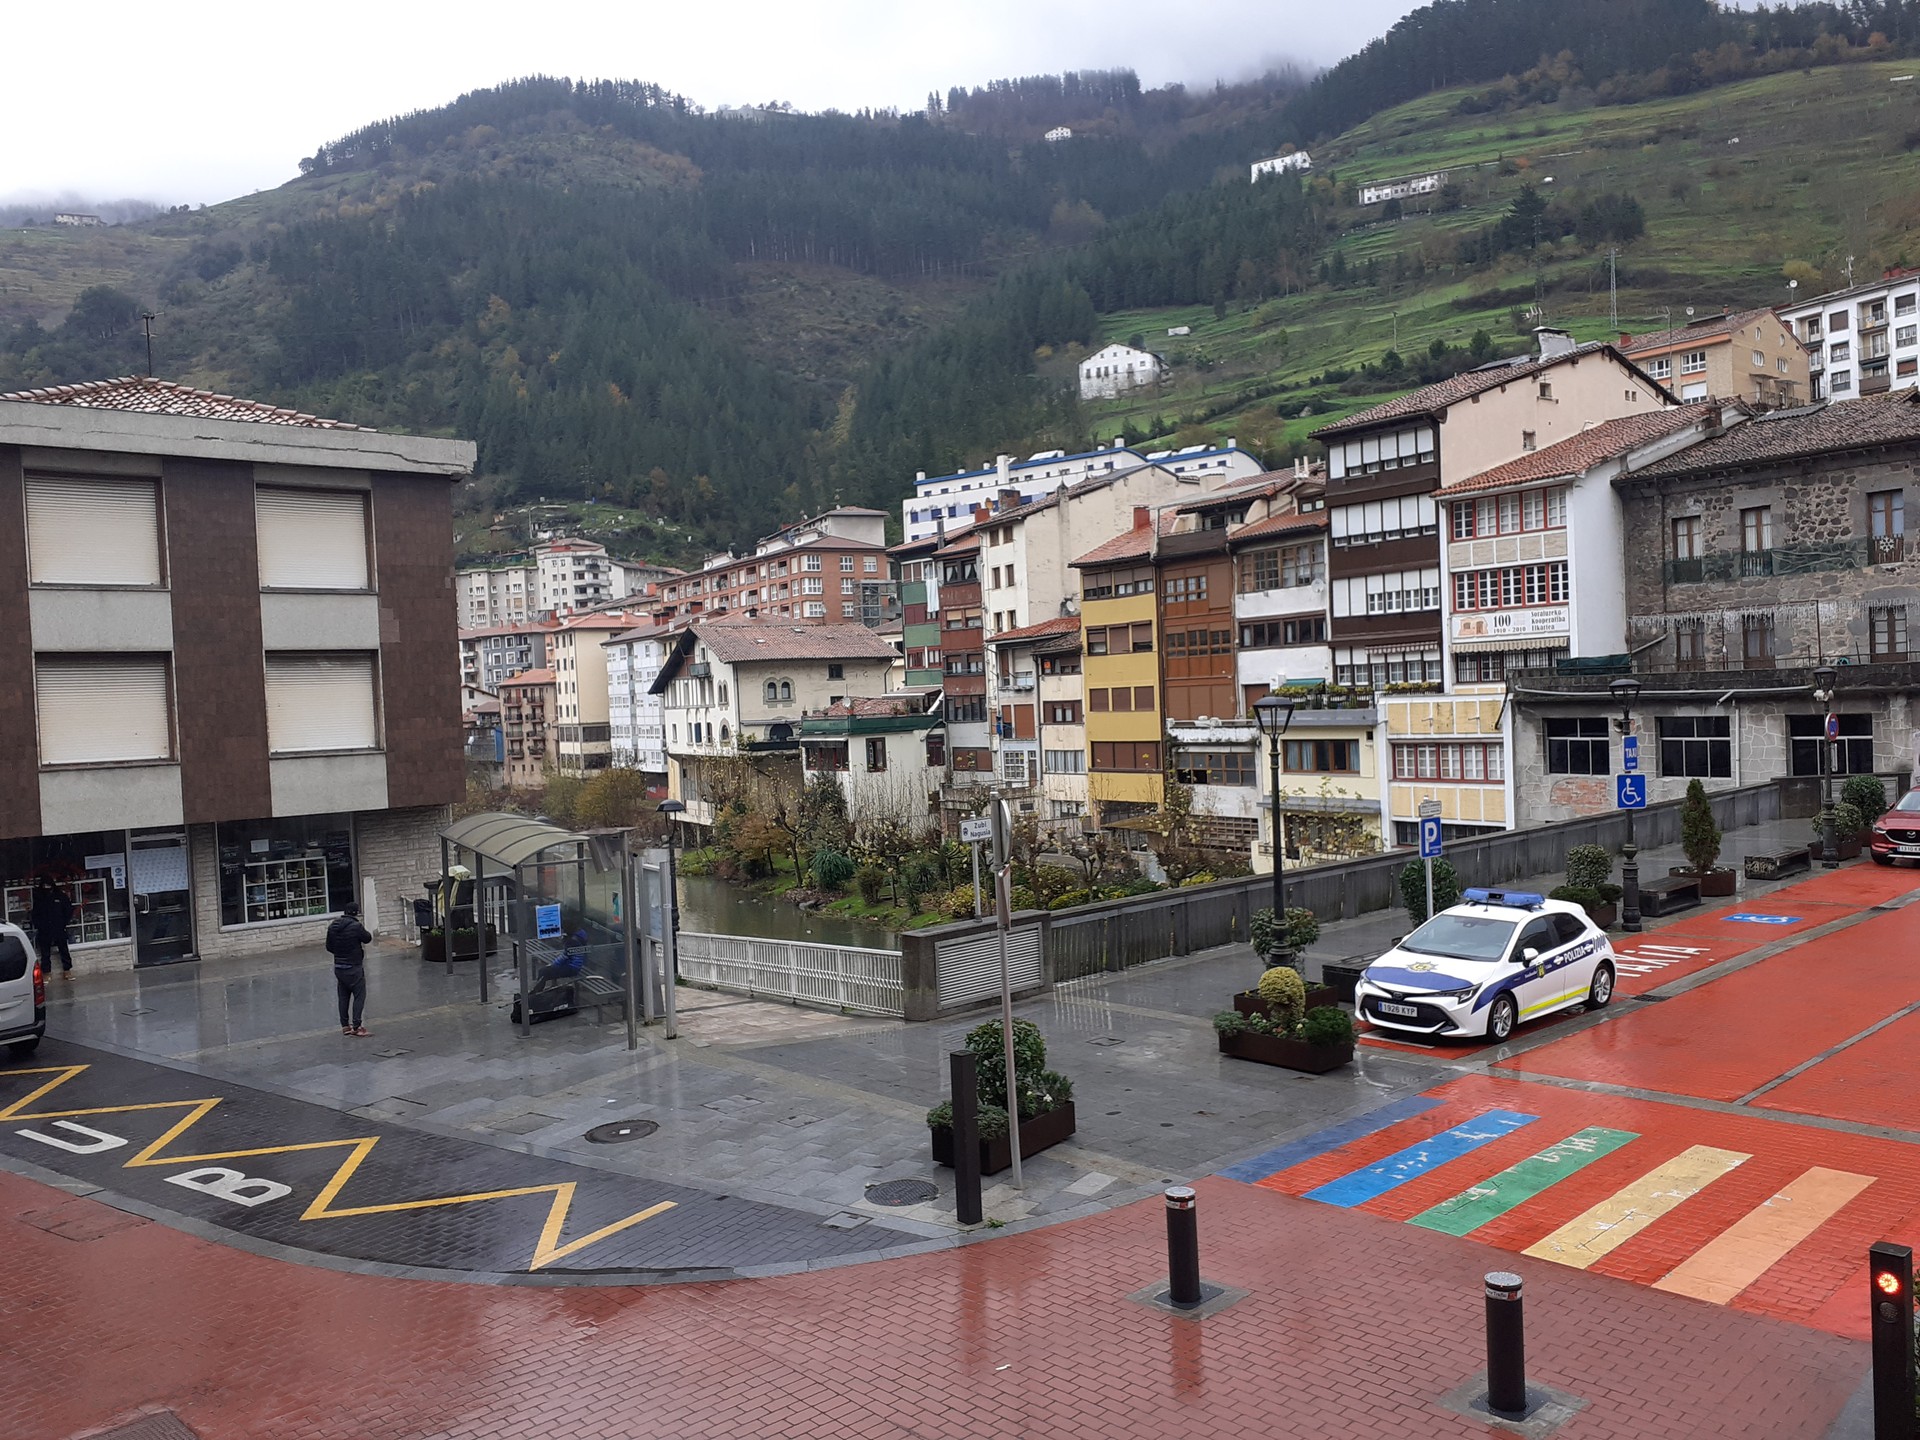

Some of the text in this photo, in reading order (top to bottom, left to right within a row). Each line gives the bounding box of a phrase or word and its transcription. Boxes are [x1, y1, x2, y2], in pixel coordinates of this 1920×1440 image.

[1493, 614, 1511, 627] 100
[1531, 616, 1566, 624] Kooperatiba
[974, 820, 987, 829] Zubi
[970, 828, 991, 838] Nagusia
[1424, 821, 1438, 854] P
[1563, 944, 1586, 963] POLIZIA
[1383, 1003, 1416, 1016] 1926 KYP
